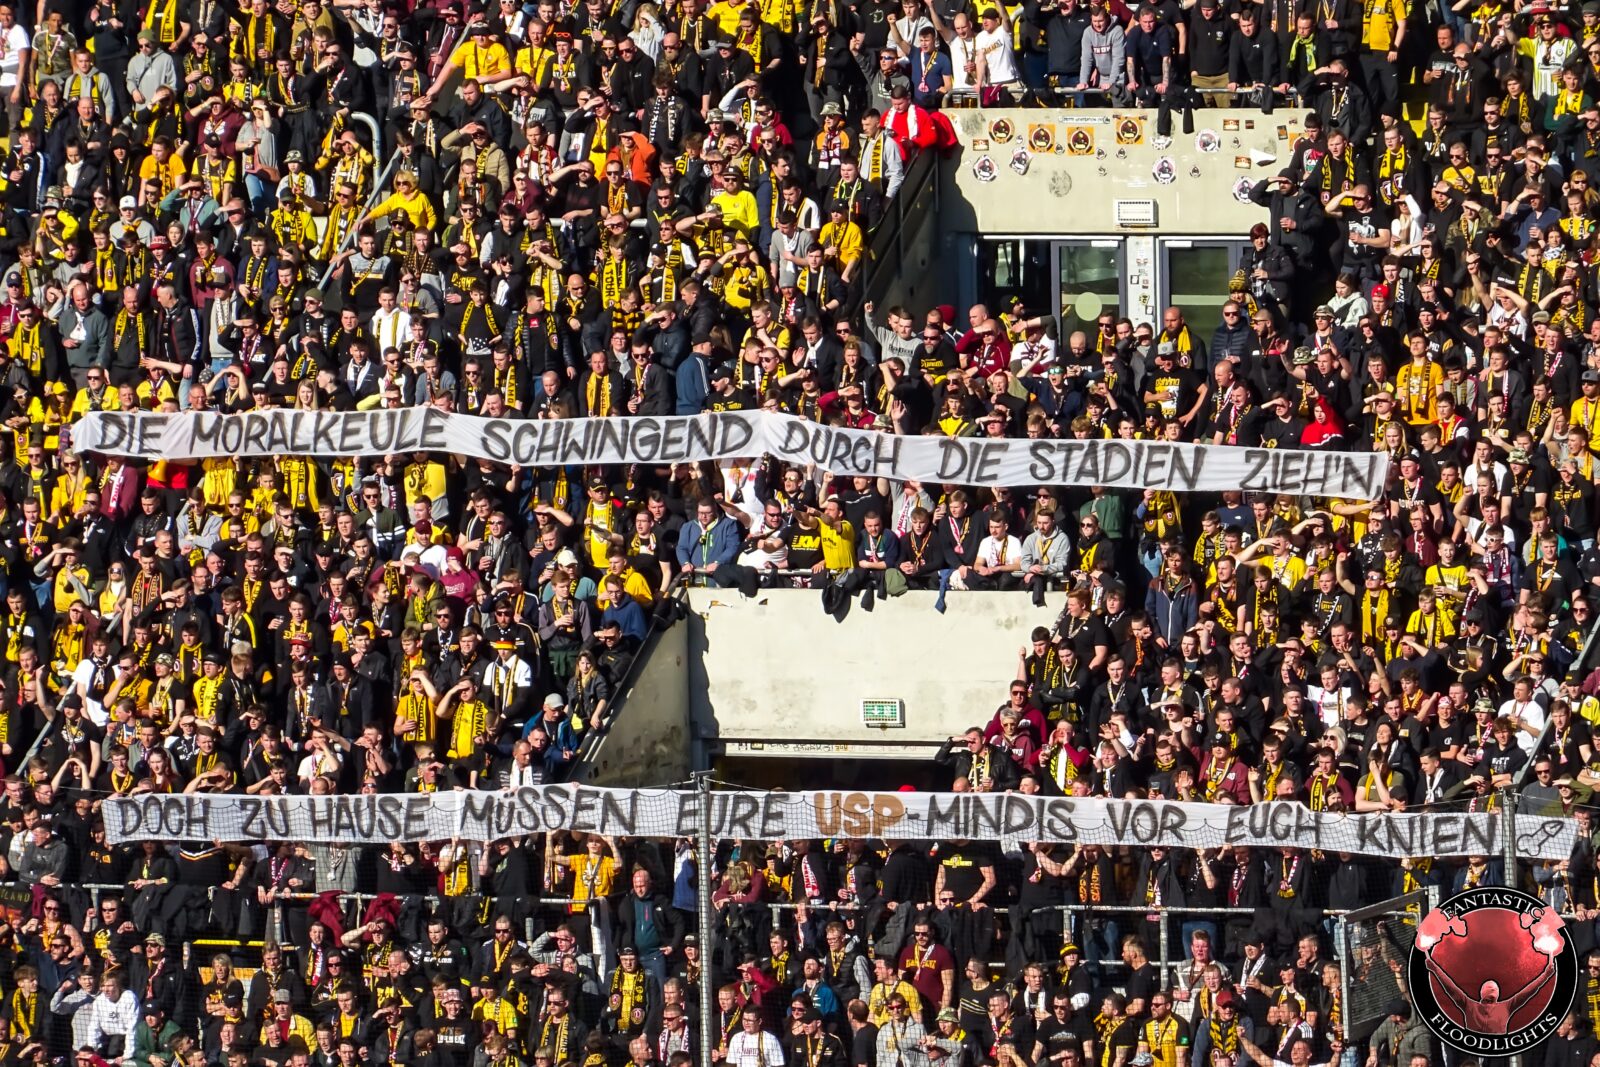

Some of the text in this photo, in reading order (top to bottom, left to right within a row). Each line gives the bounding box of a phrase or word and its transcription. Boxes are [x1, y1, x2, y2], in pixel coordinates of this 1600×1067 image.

[95, 411, 169, 454] DIE
[189, 407, 450, 454] MORALKEULE
[481, 413, 753, 463] SCHWINGEND
[777, 420, 902, 474] DURCH
[936, 438, 1009, 482] DIE
[1029, 439, 1208, 490] STADIEN
[119, 795, 210, 838] DOCH
[239, 794, 290, 839] ZU
[310, 794, 430, 840] HAUSE
[460, 785, 639, 840] MÜSSEN
[675, 792, 790, 838] EURE
[1106, 800, 1188, 843] VOR
[1225, 801, 1321, 845] EUCH
[1358, 813, 1498, 856] KNIEN
